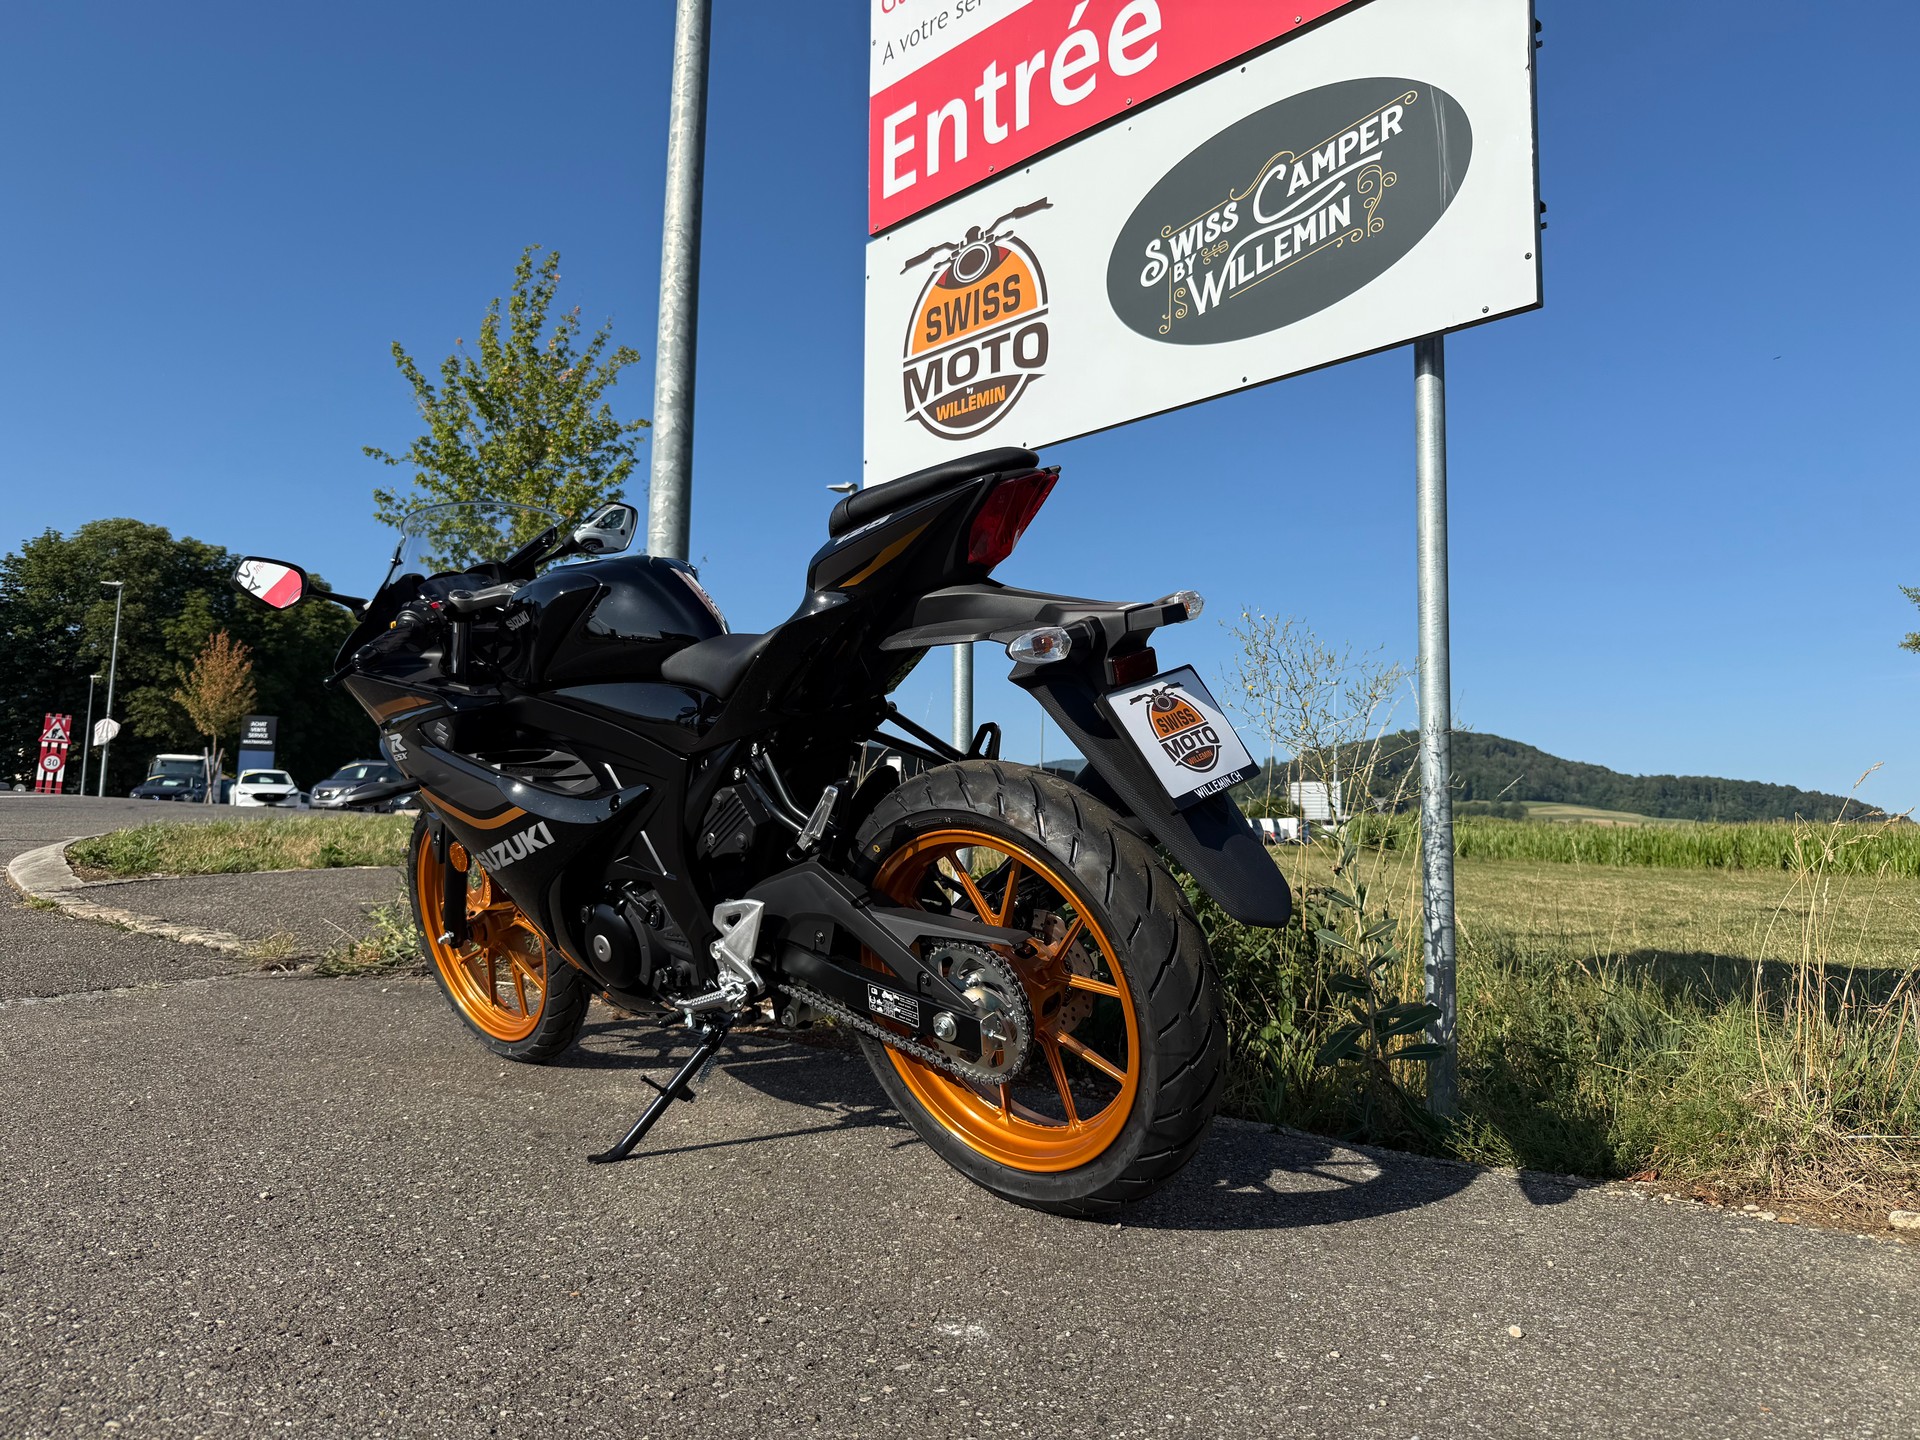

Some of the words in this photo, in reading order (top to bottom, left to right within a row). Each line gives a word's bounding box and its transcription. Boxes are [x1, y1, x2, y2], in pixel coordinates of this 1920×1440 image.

[882, 41, 895, 66] A
[899, 10, 949, 53] votre
[882, 0, 1162, 200] Entrée
[1140, 201, 1240, 288] SWISS
[1252, 104, 1405, 225] CAMPER
[1172, 252, 1197, 284] BY
[1186, 180, 1352, 317] WILLEMIN
[925, 273, 1022, 343] SWISS
[902, 321, 1049, 415] MOTO
[935, 384, 1007, 422] WILLEMIN
[1156, 708, 1196, 733] SWISS
[1161, 726, 1220, 763] MOTO
[46, 758, 58, 767] 30
[1194, 771, 1243, 798] WILLEMIN.CH
[476, 820, 556, 874] SUZUKI
